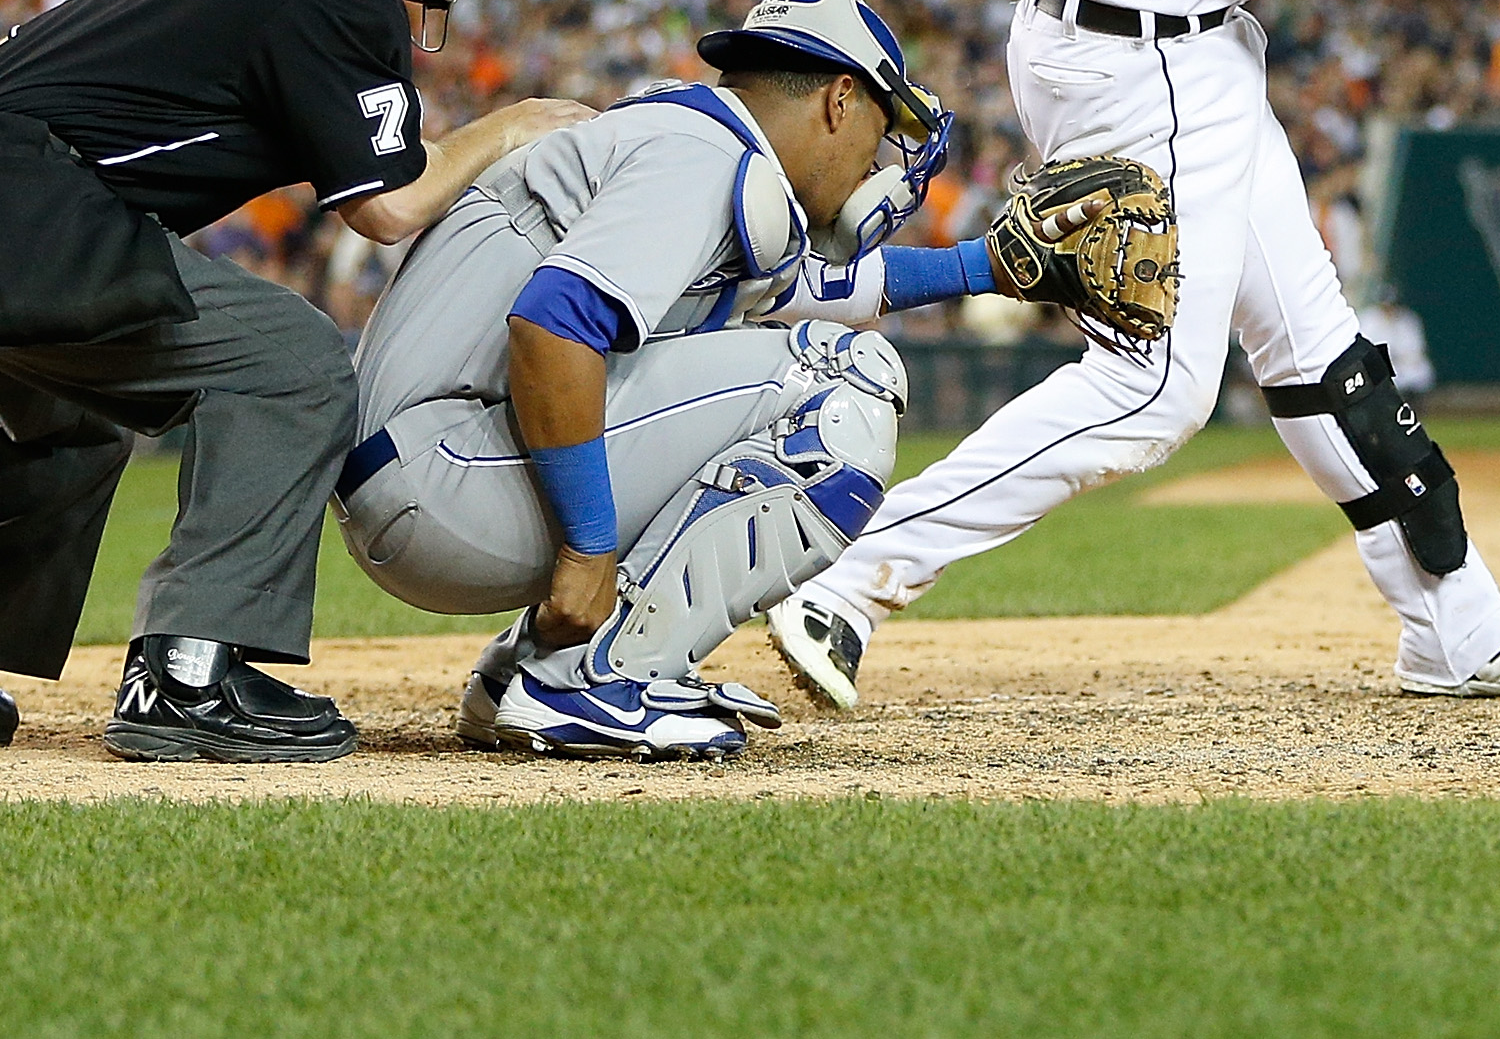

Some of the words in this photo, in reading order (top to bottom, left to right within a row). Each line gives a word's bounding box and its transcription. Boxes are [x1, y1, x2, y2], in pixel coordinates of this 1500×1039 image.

[357, 83, 409, 156] 7
[1344, 371, 1365, 395] 24
[118, 678, 159, 715] N
